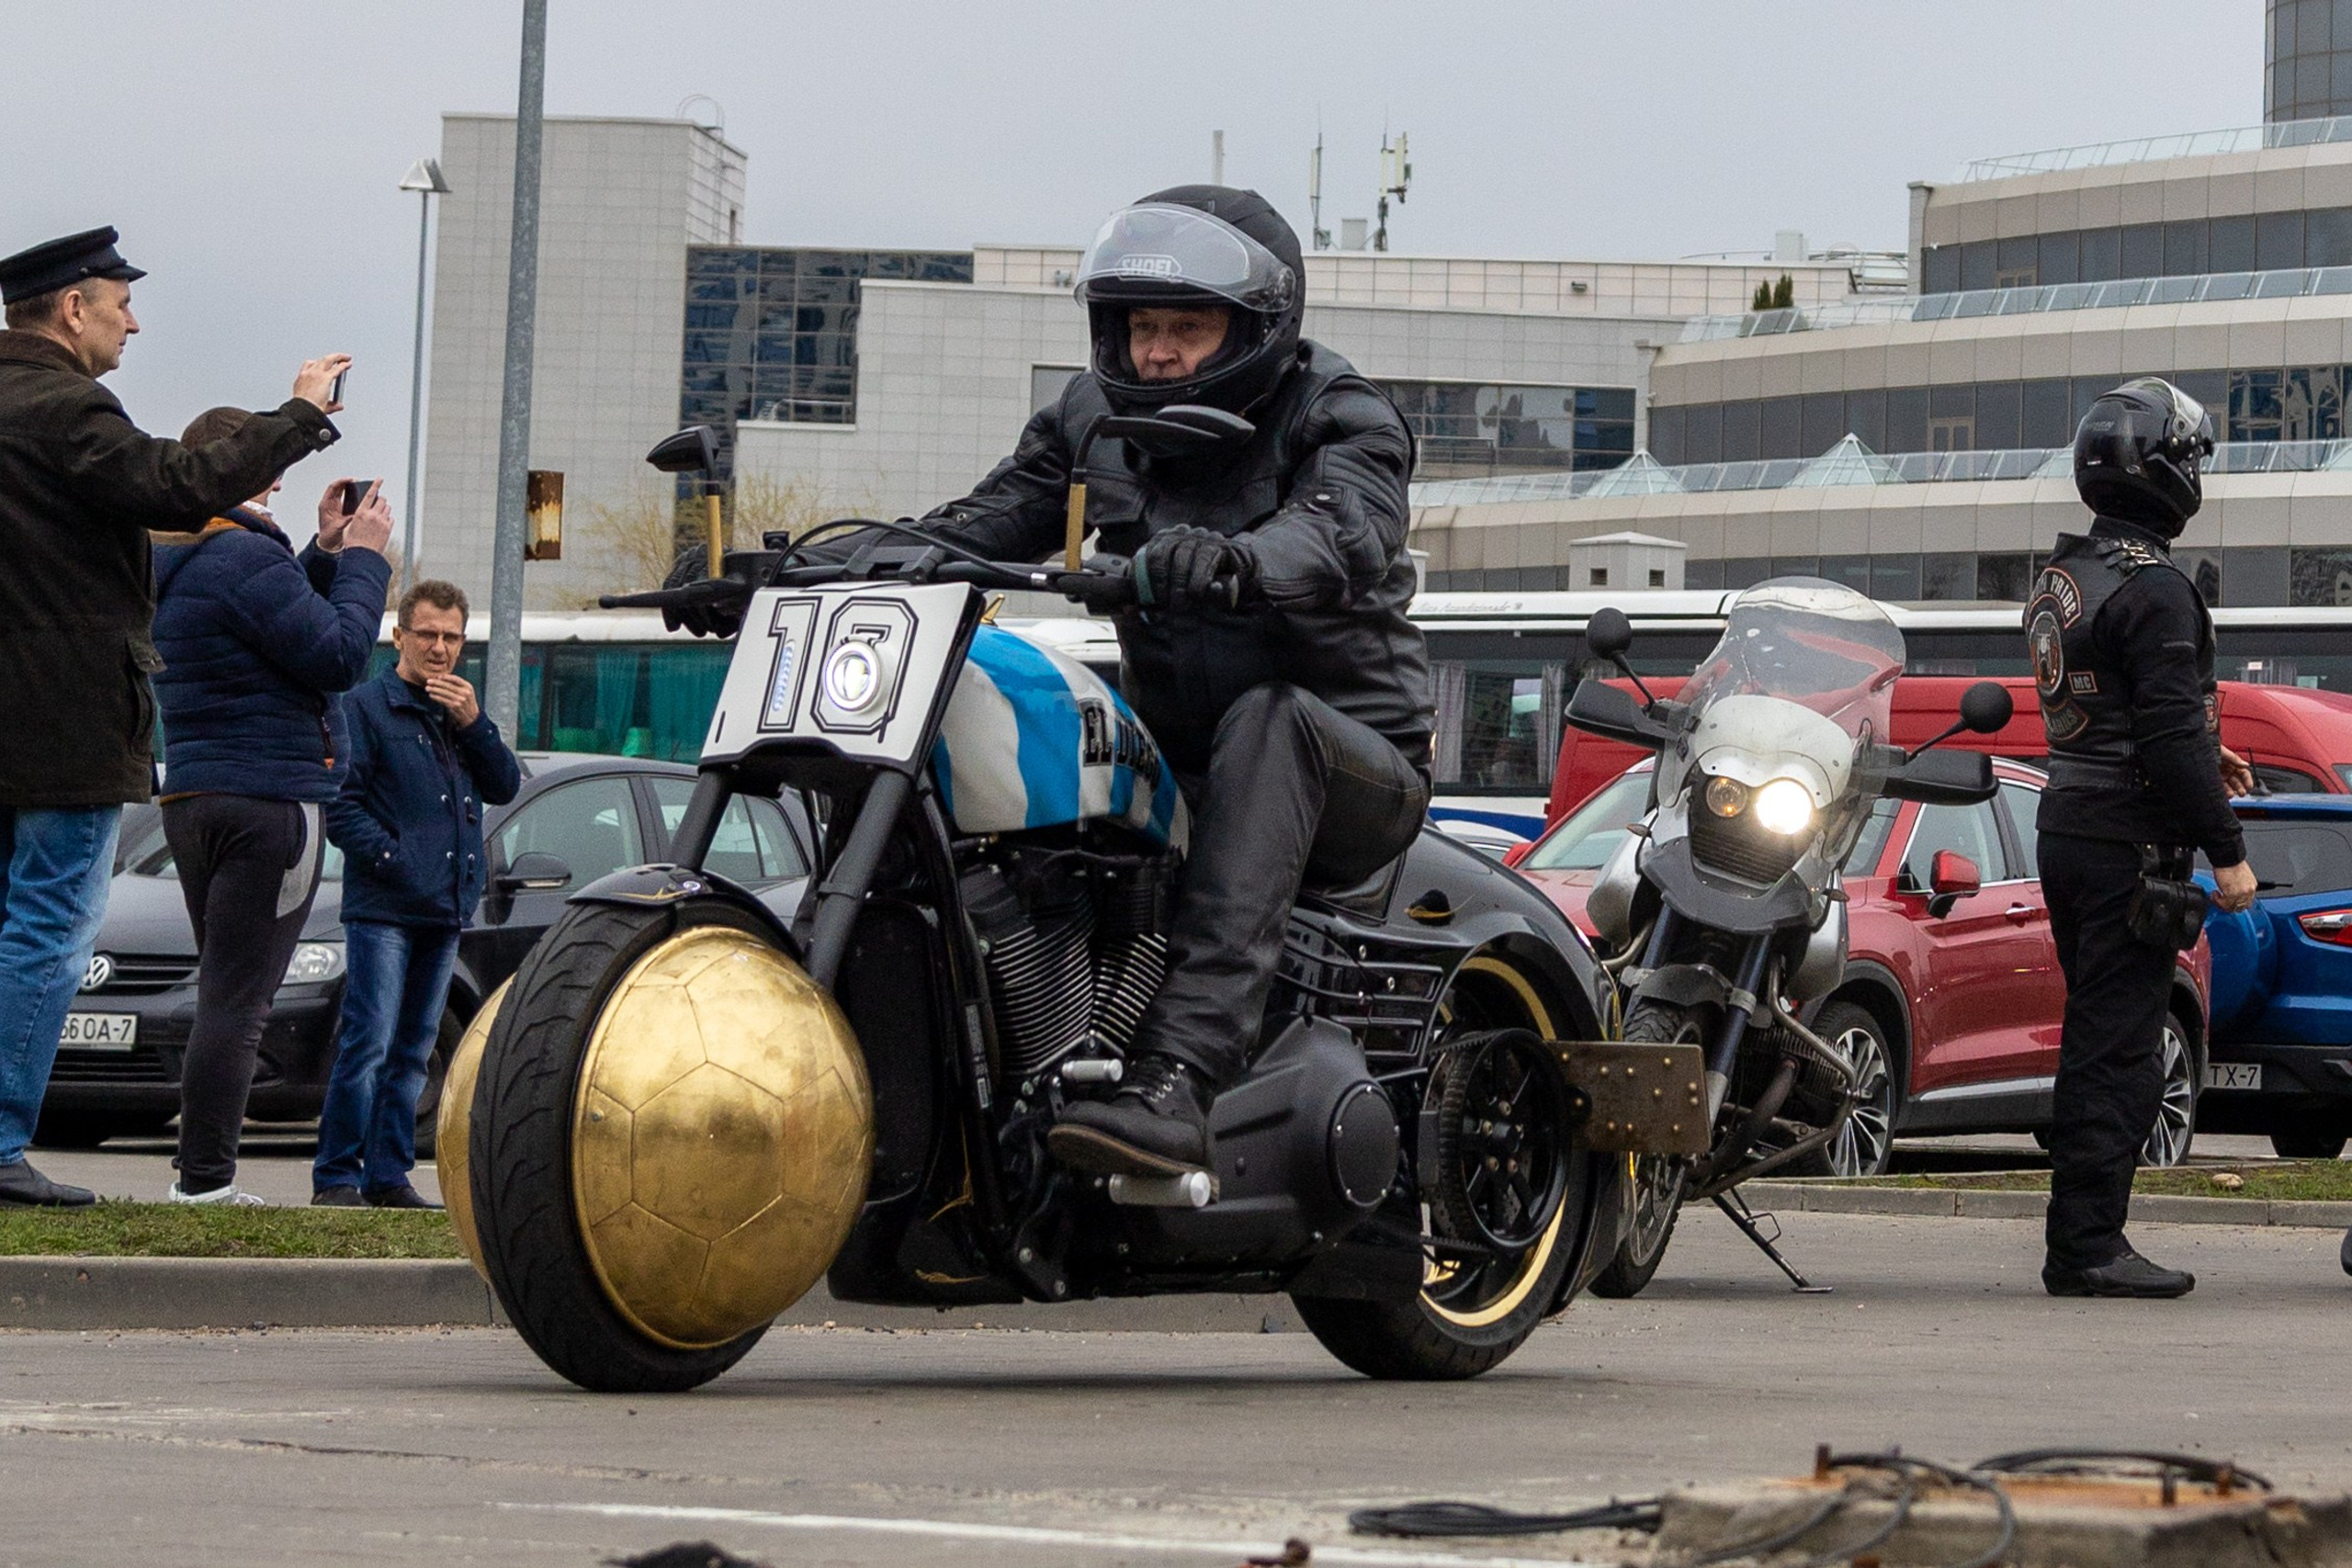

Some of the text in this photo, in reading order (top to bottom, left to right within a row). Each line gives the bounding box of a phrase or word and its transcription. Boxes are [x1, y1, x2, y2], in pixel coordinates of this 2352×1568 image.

[1121, 257, 1172, 278] SHOEI
[2050, 573, 2077, 619] PRIDE
[2072, 675, 2092, 691] MC
[1076, 698, 1114, 767] EL
